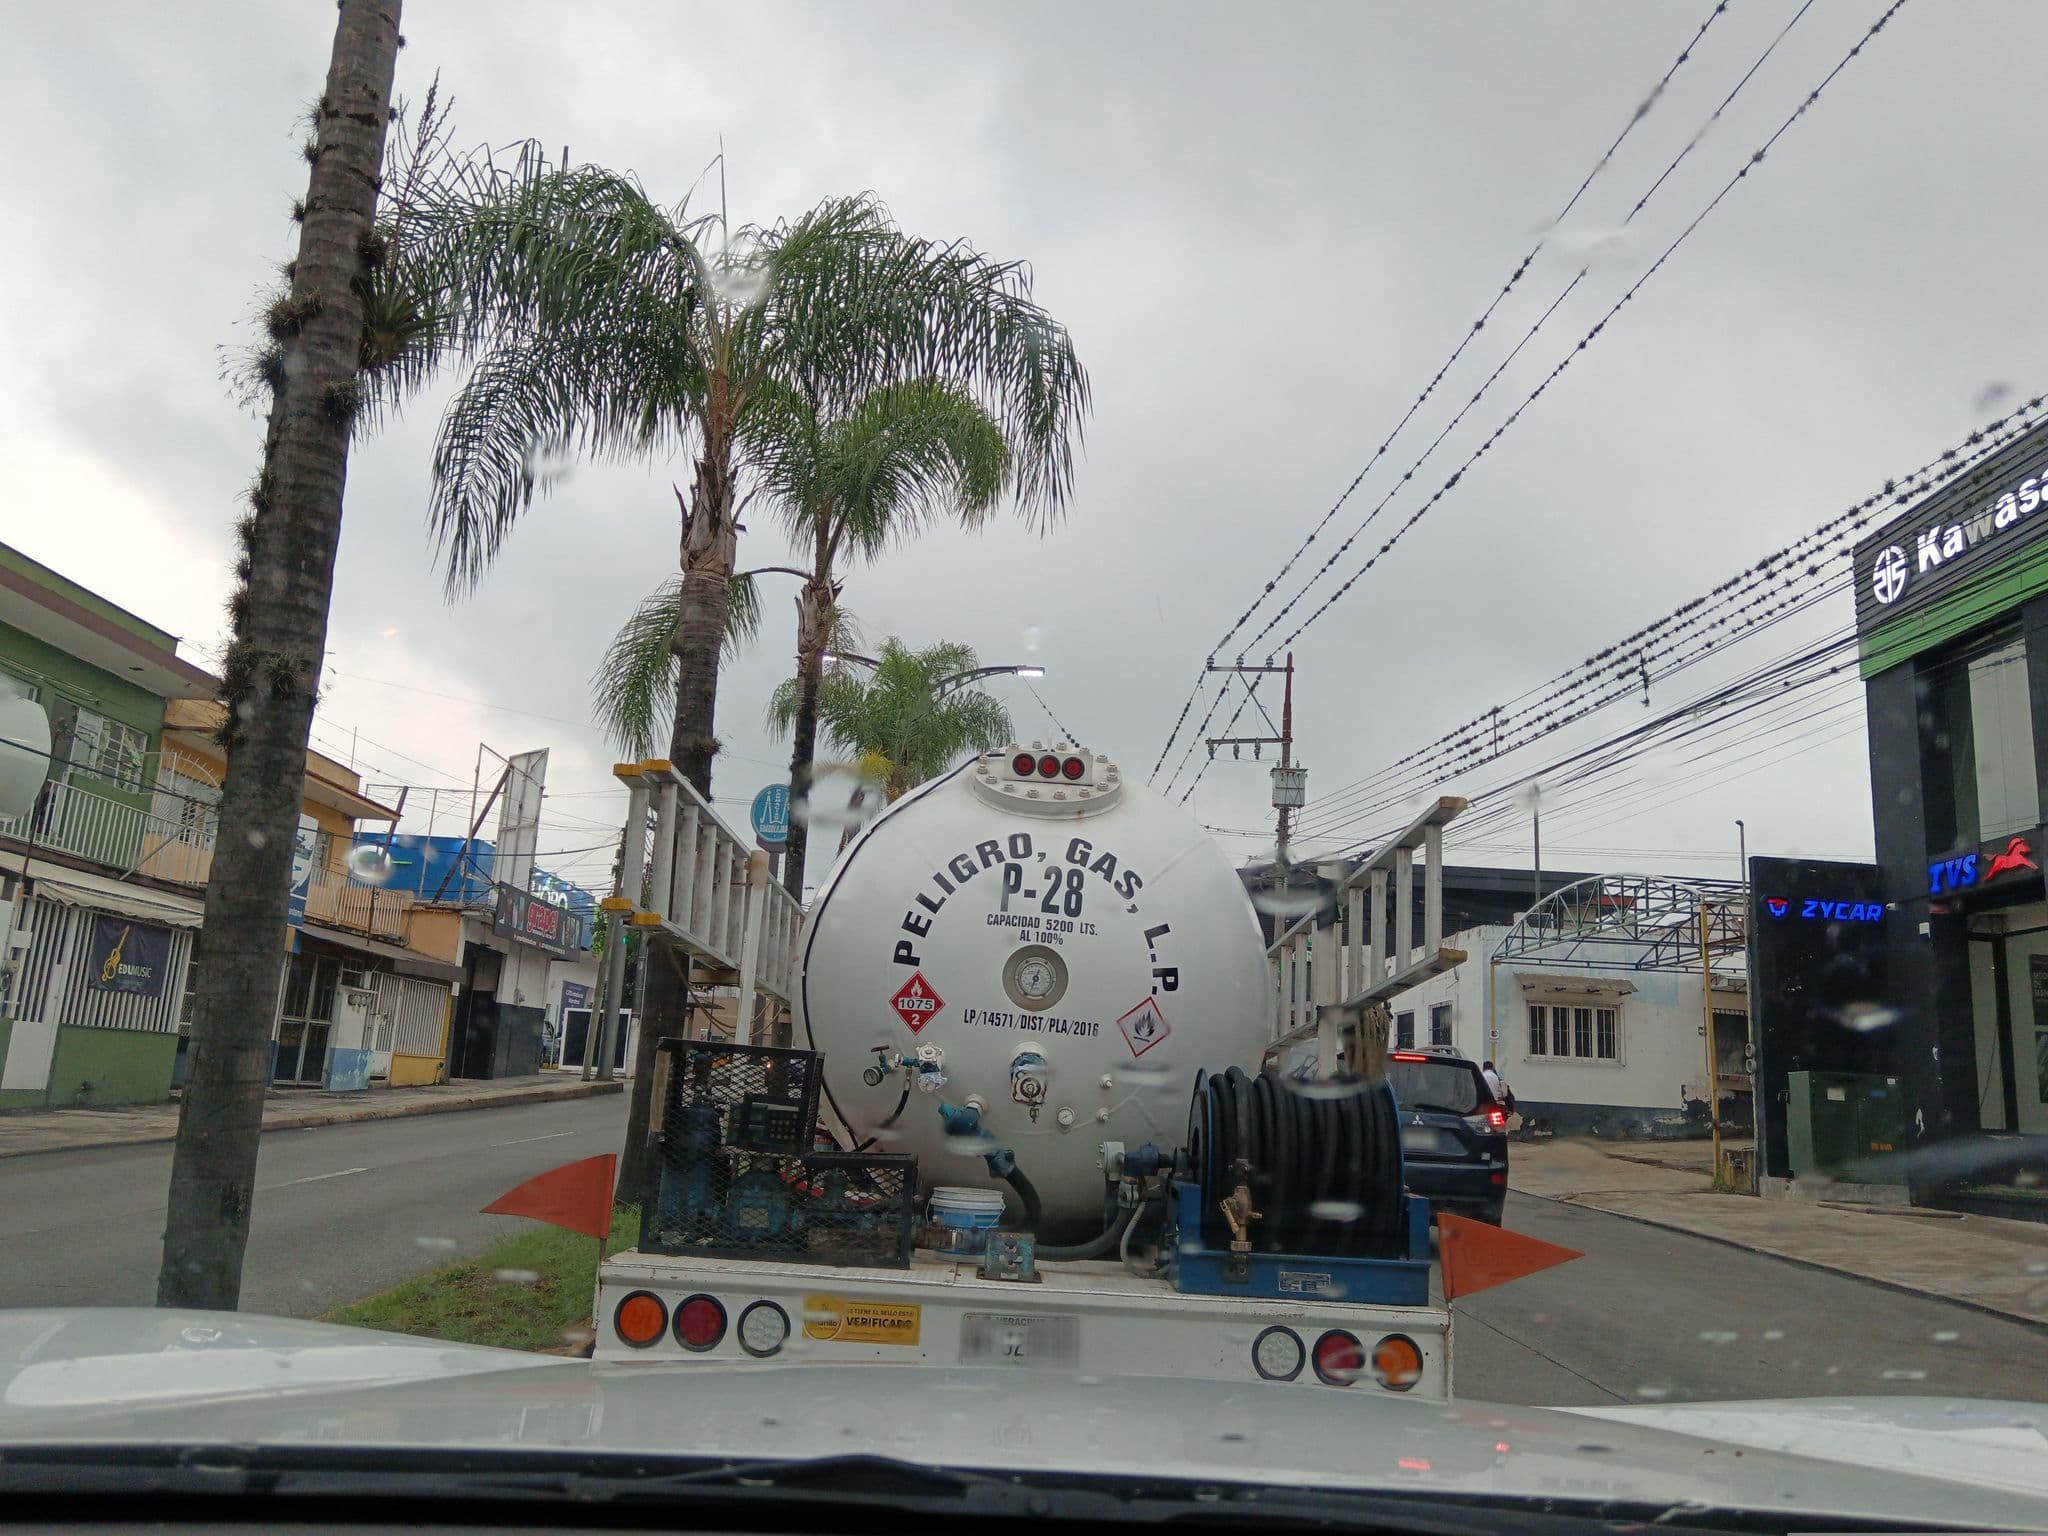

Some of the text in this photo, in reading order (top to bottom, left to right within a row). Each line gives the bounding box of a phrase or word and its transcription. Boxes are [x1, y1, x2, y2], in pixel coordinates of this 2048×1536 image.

[1928, 854, 1978, 895] TVS
[1000, 862, 1085, 918] P-28
[893, 832, 1179, 996] PELIGRO, GAS, L.P.
[1801, 898, 1883, 922] ZYCAR
[986, 913, 1098, 936] CAPACIDAD 5200 LTS.
[1019, 929, 1064, 945] AL 100%
[118, 963, 152, 978] EDUMUSIC
[899, 999, 933, 1010] 1075
[911, 1013, 920, 1025] 2
[963, 1008, 1099, 1037] LP/14571/DIST/PLA/2016
[846, 1316, 914, 1330] VERIFICADO
